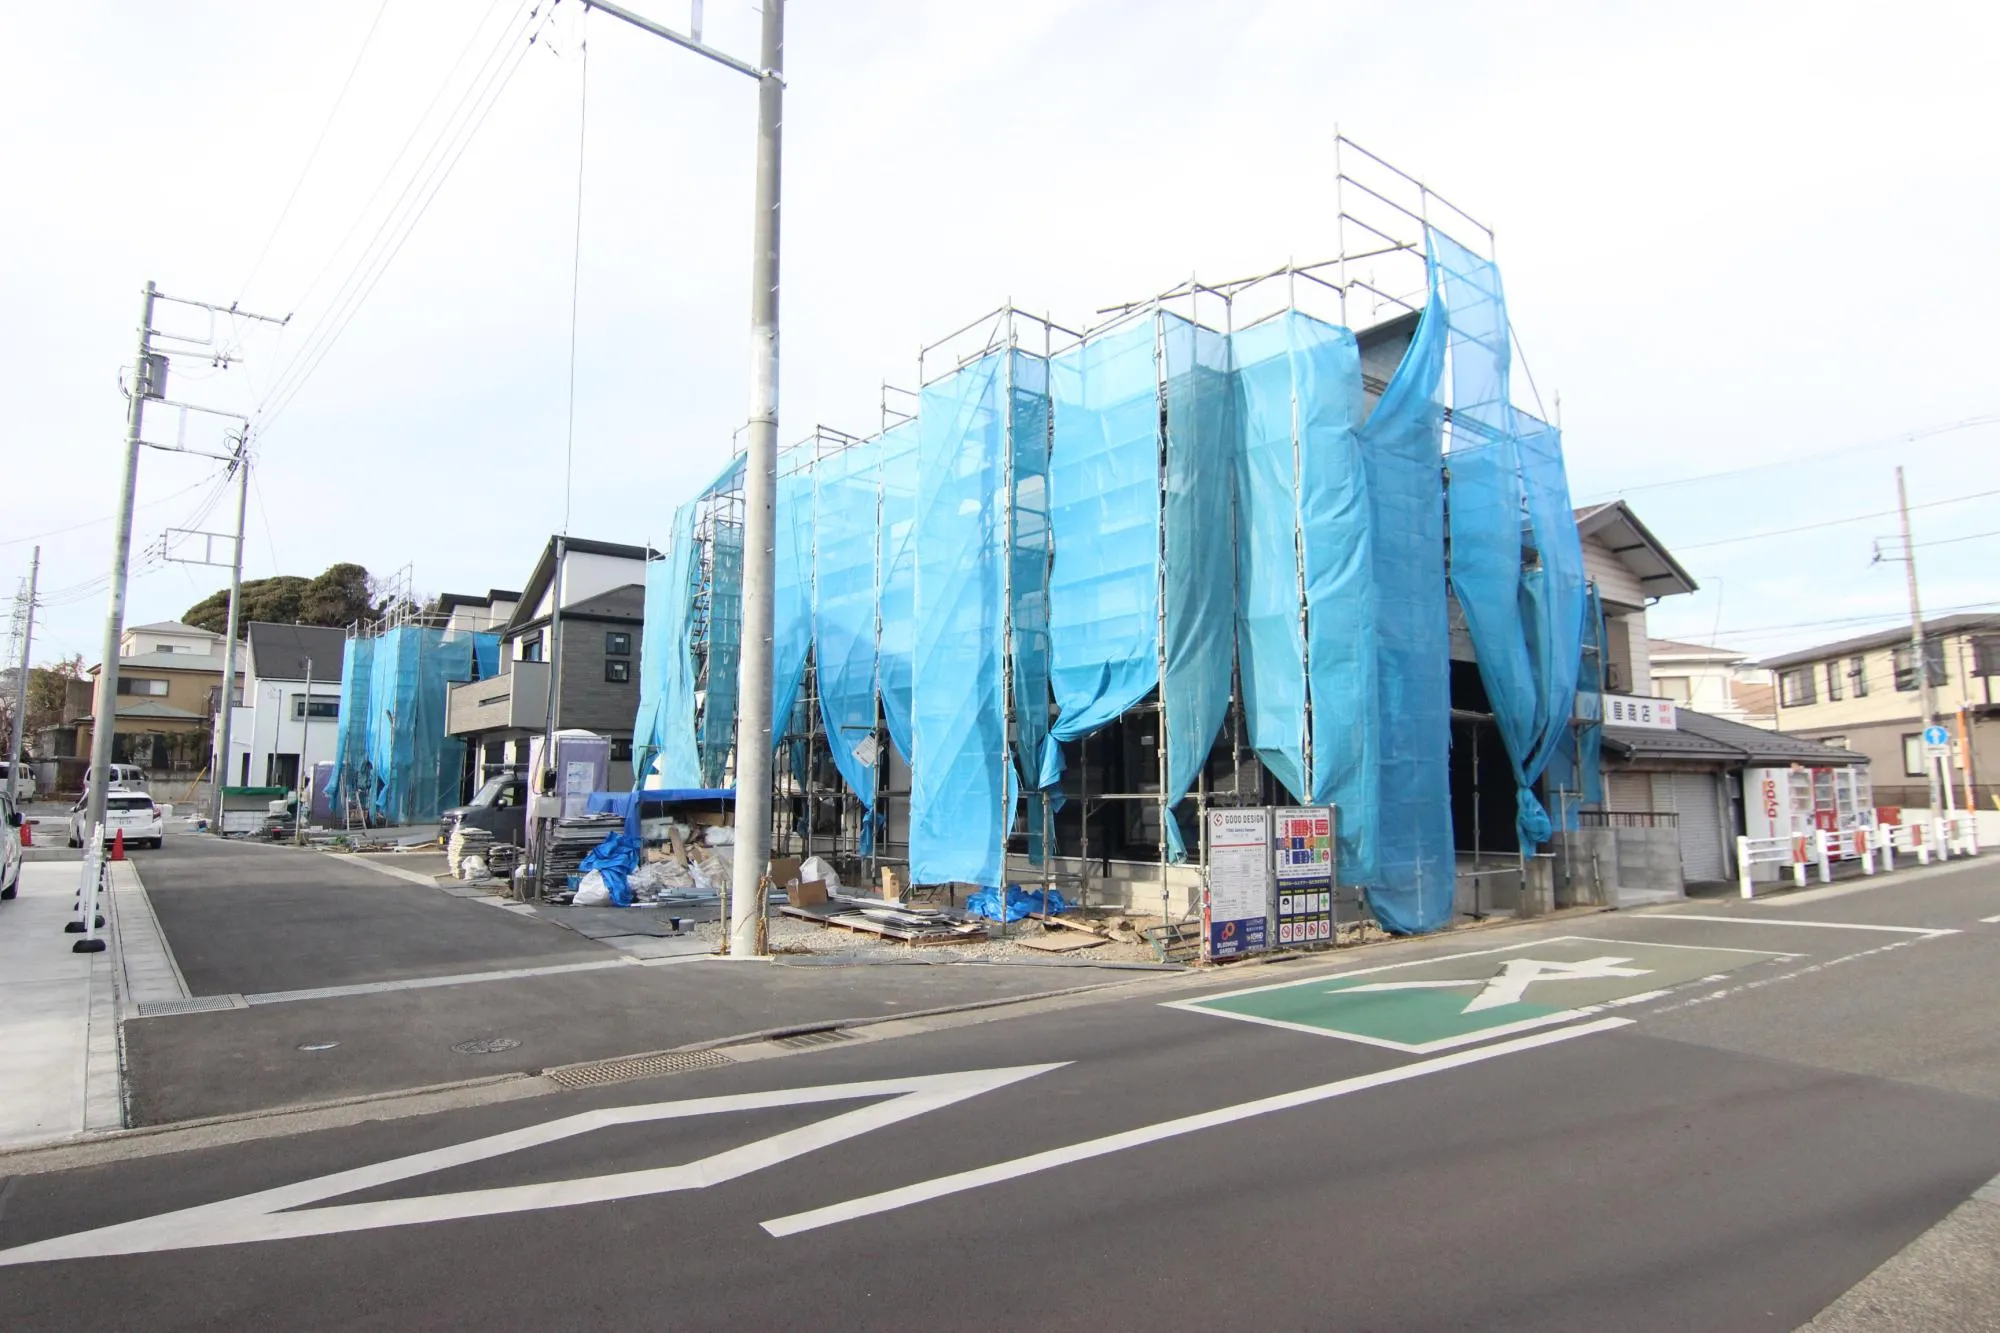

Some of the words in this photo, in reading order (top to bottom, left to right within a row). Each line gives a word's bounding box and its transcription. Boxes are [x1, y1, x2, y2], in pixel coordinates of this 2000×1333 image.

[1767, 781, 1779, 818] DyDo
[1225, 815, 1241, 824] GOOD
[1243, 814, 1264, 823] DESIGN
